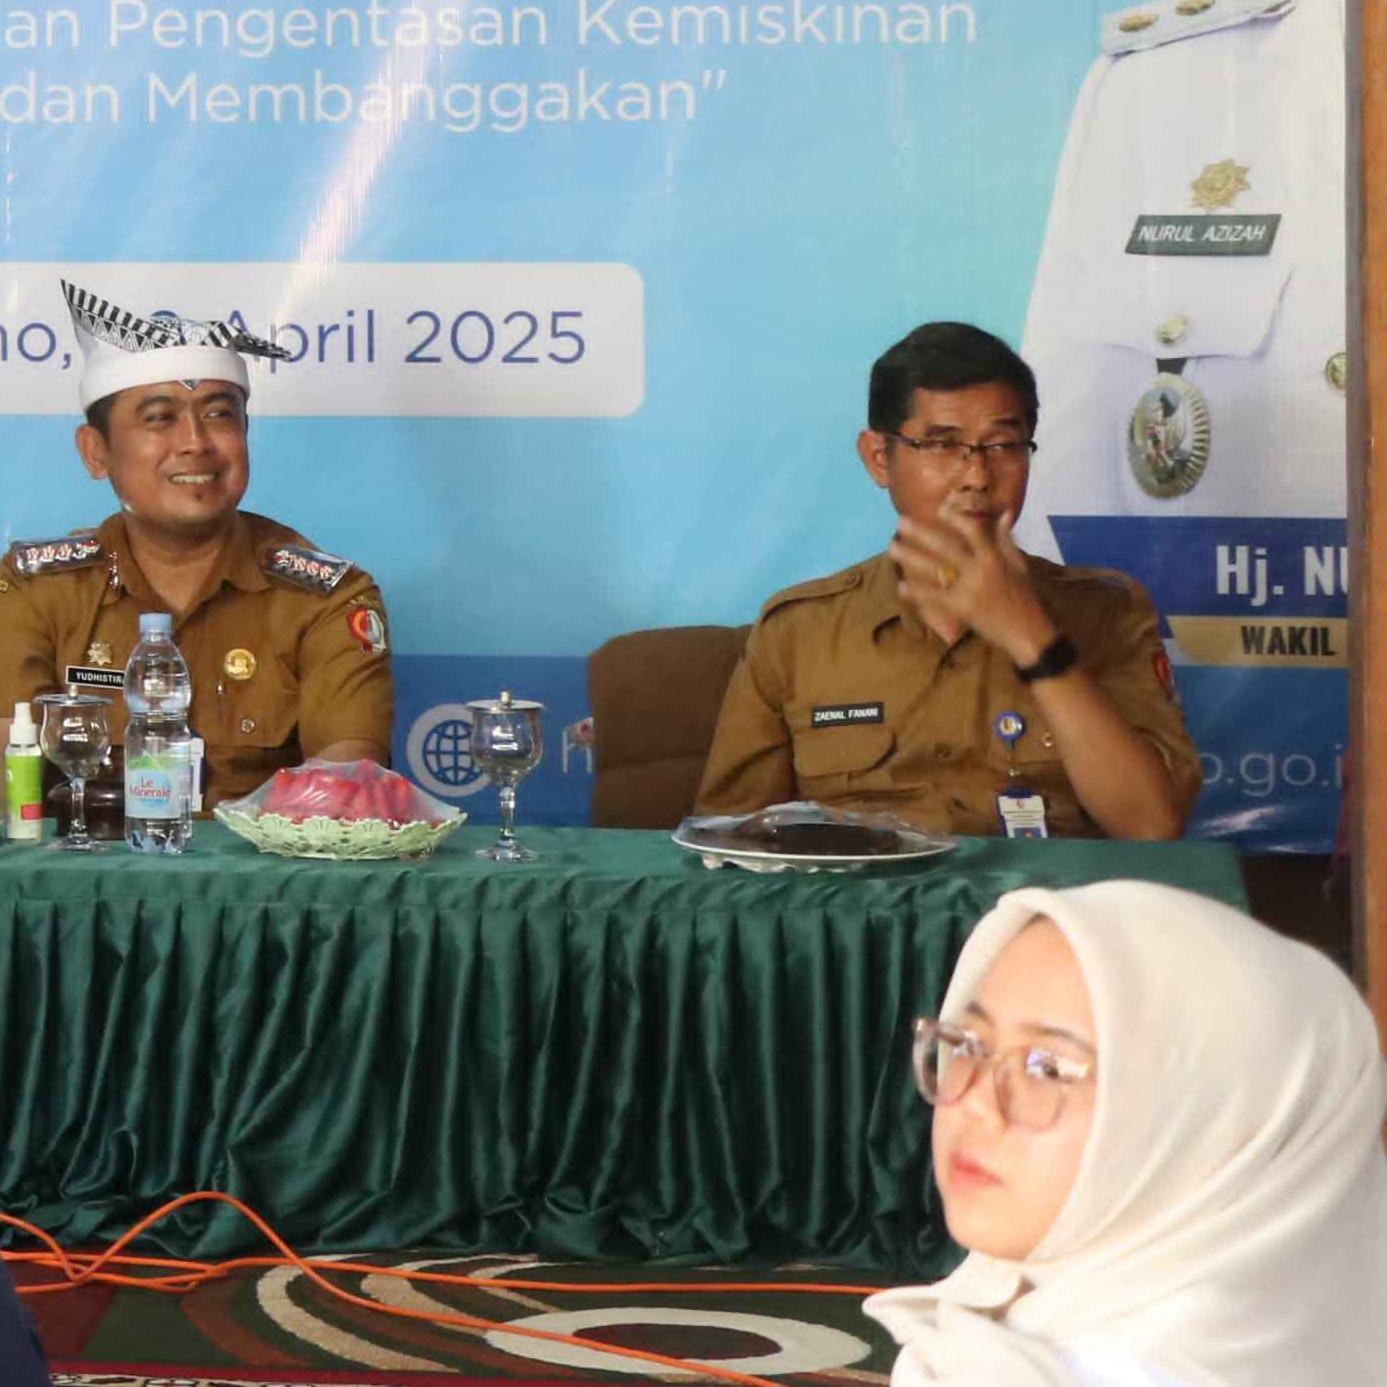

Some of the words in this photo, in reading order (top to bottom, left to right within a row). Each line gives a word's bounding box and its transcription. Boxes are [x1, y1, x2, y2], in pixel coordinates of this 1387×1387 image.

[146, 67, 728, 133] Membanggakan"
[1138, 225, 1195, 242] NURUL
[1202, 226, 1267, 242] AZIZAH
[404, 309, 586, 366] 2025
[1215, 544, 1284, 607] Hj.
[1240, 625, 1337, 656] WAKIL
[75, 671, 124, 685] YUDHISTIR
[140, 774, 155, 788] Le
